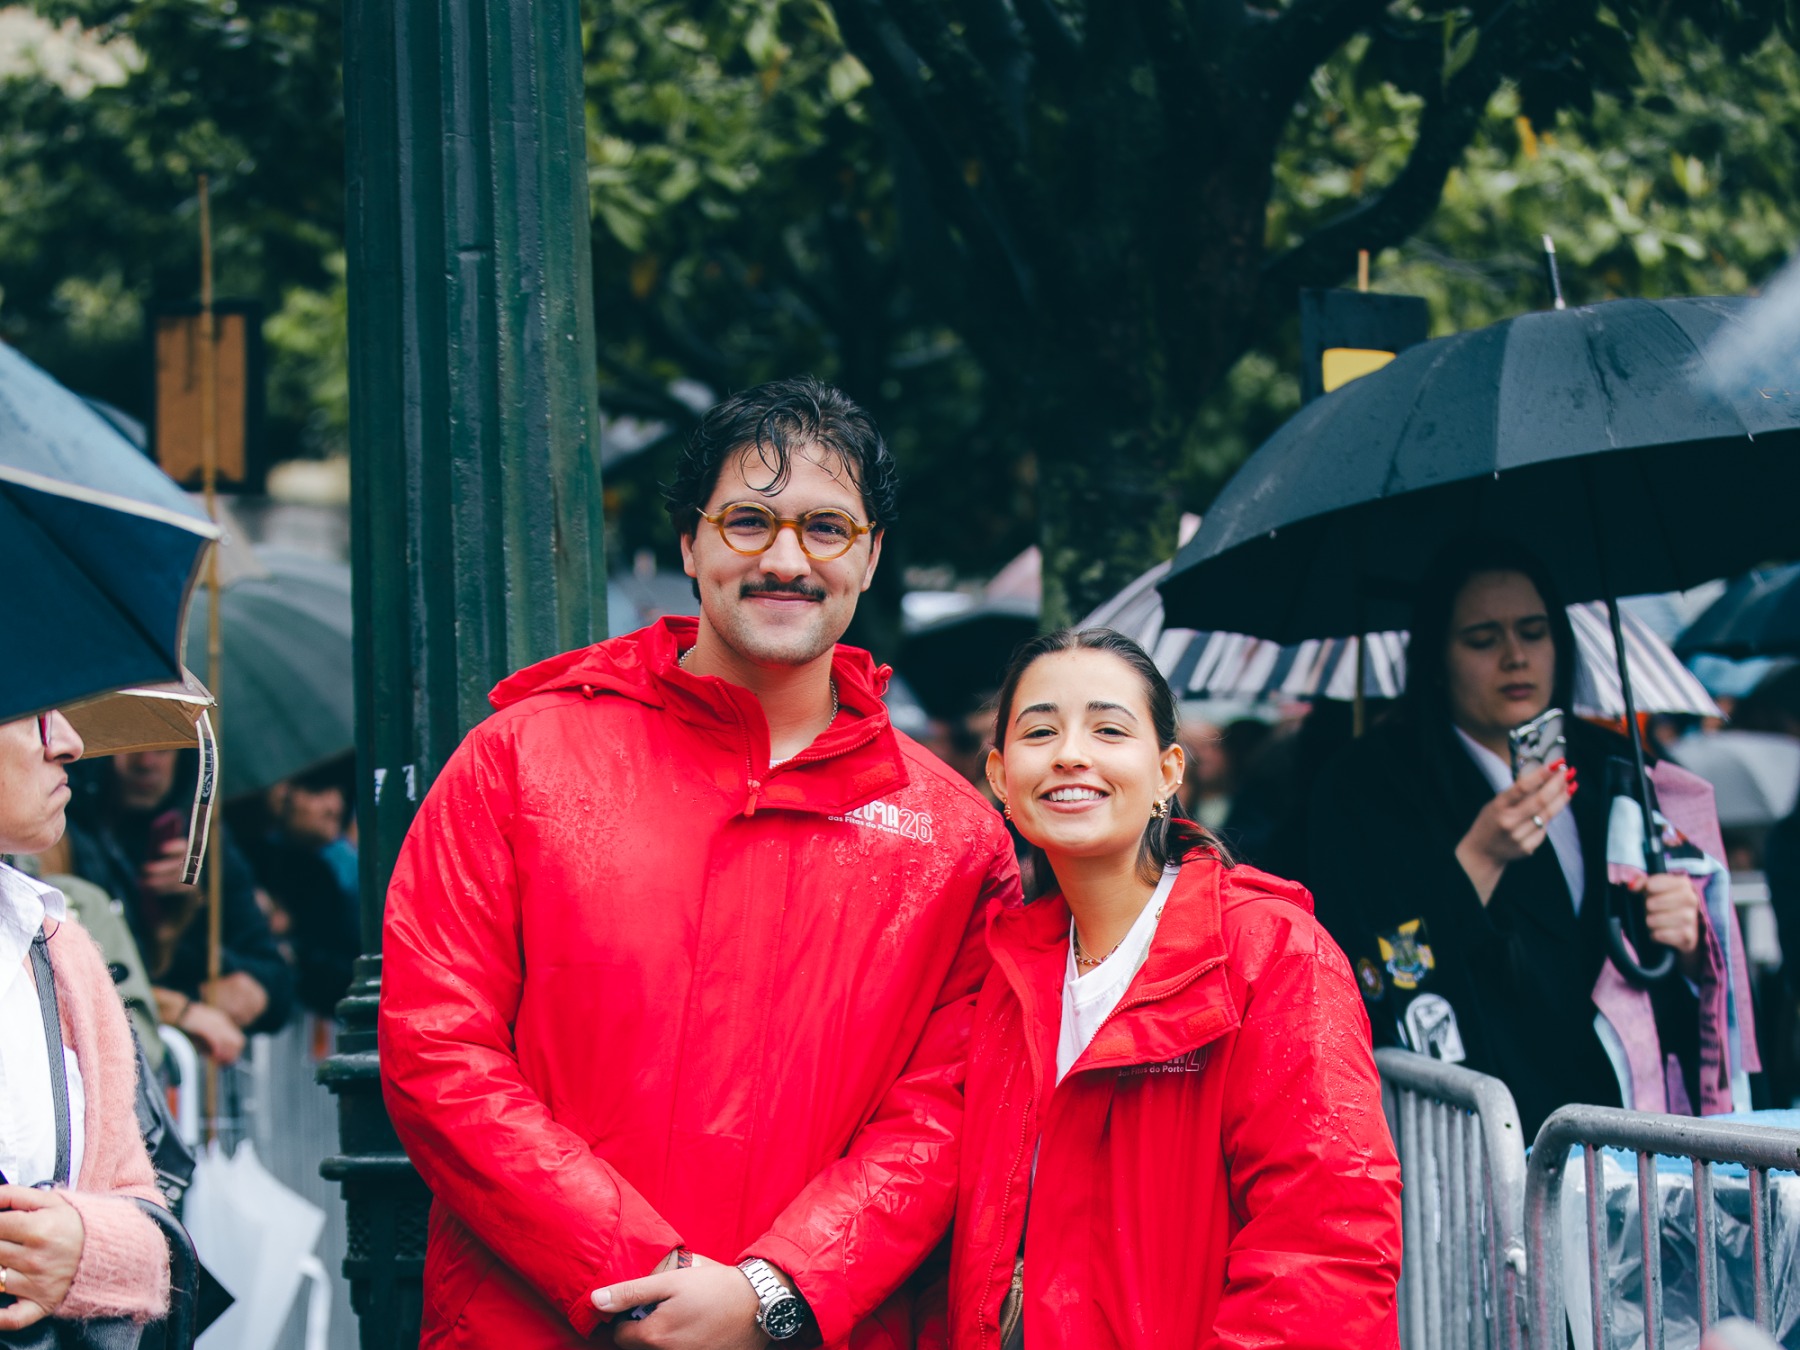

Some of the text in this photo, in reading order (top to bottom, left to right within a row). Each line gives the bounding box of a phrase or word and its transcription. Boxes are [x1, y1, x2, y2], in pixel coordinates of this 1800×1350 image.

[845, 816, 864, 826] Fitas
[866, 821, 876, 829] do
[878, 823, 899, 834] Porto
[1149, 1065, 1160, 1073] do
[1162, 1065, 1184, 1073] Porto
